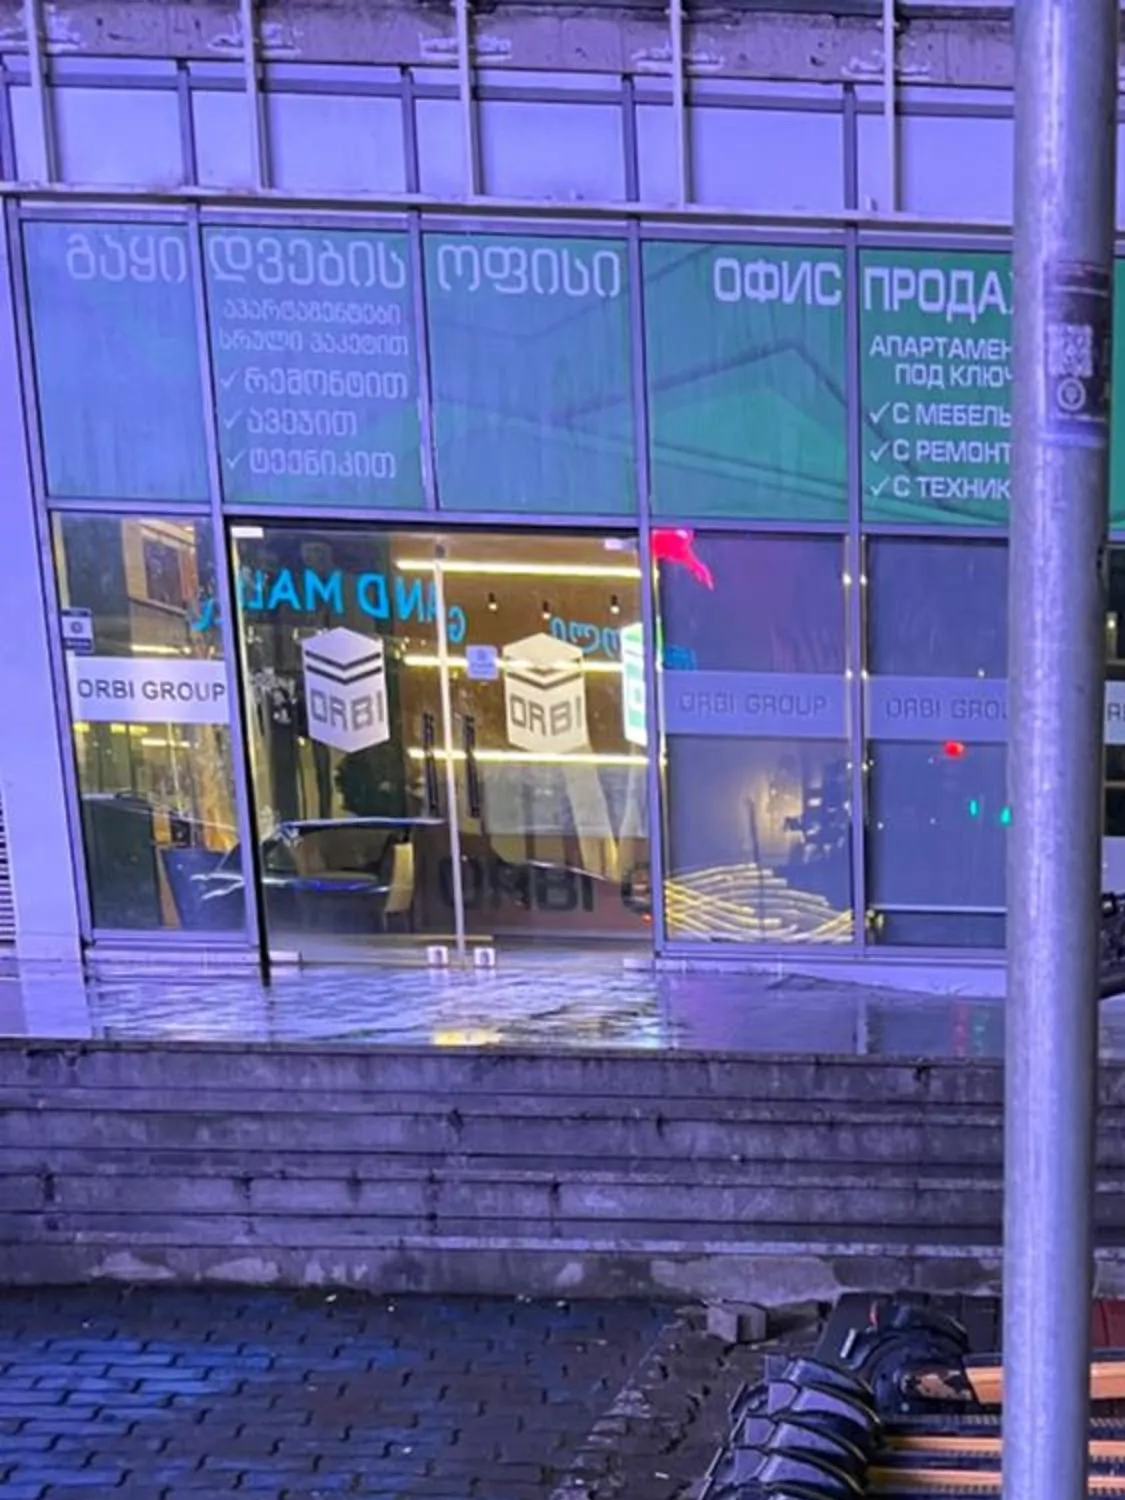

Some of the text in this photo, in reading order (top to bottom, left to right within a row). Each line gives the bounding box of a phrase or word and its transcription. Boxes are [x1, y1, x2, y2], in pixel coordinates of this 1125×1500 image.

[437, 244, 621, 298] ოფისი
[713, 257, 1014, 324] ОФИС ПРОДА
[869, 334, 1013, 361] АПАРТАМЕН
[895, 363, 946, 390] ПОД
[892, 401, 1012, 428] С МЕБЕЛЬ
[892, 438, 1012, 464] С РЕМОНТ
[892, 474, 1012, 499] С ТЕХНИК
[77, 678, 226, 702] ORBI GROUP
[679, 690, 828, 717] ORBI GROUP
[308, 687, 384, 733] ORBI
[509, 694, 582, 736] ORBI
[886, 698, 1007, 720] ORBI GRO
